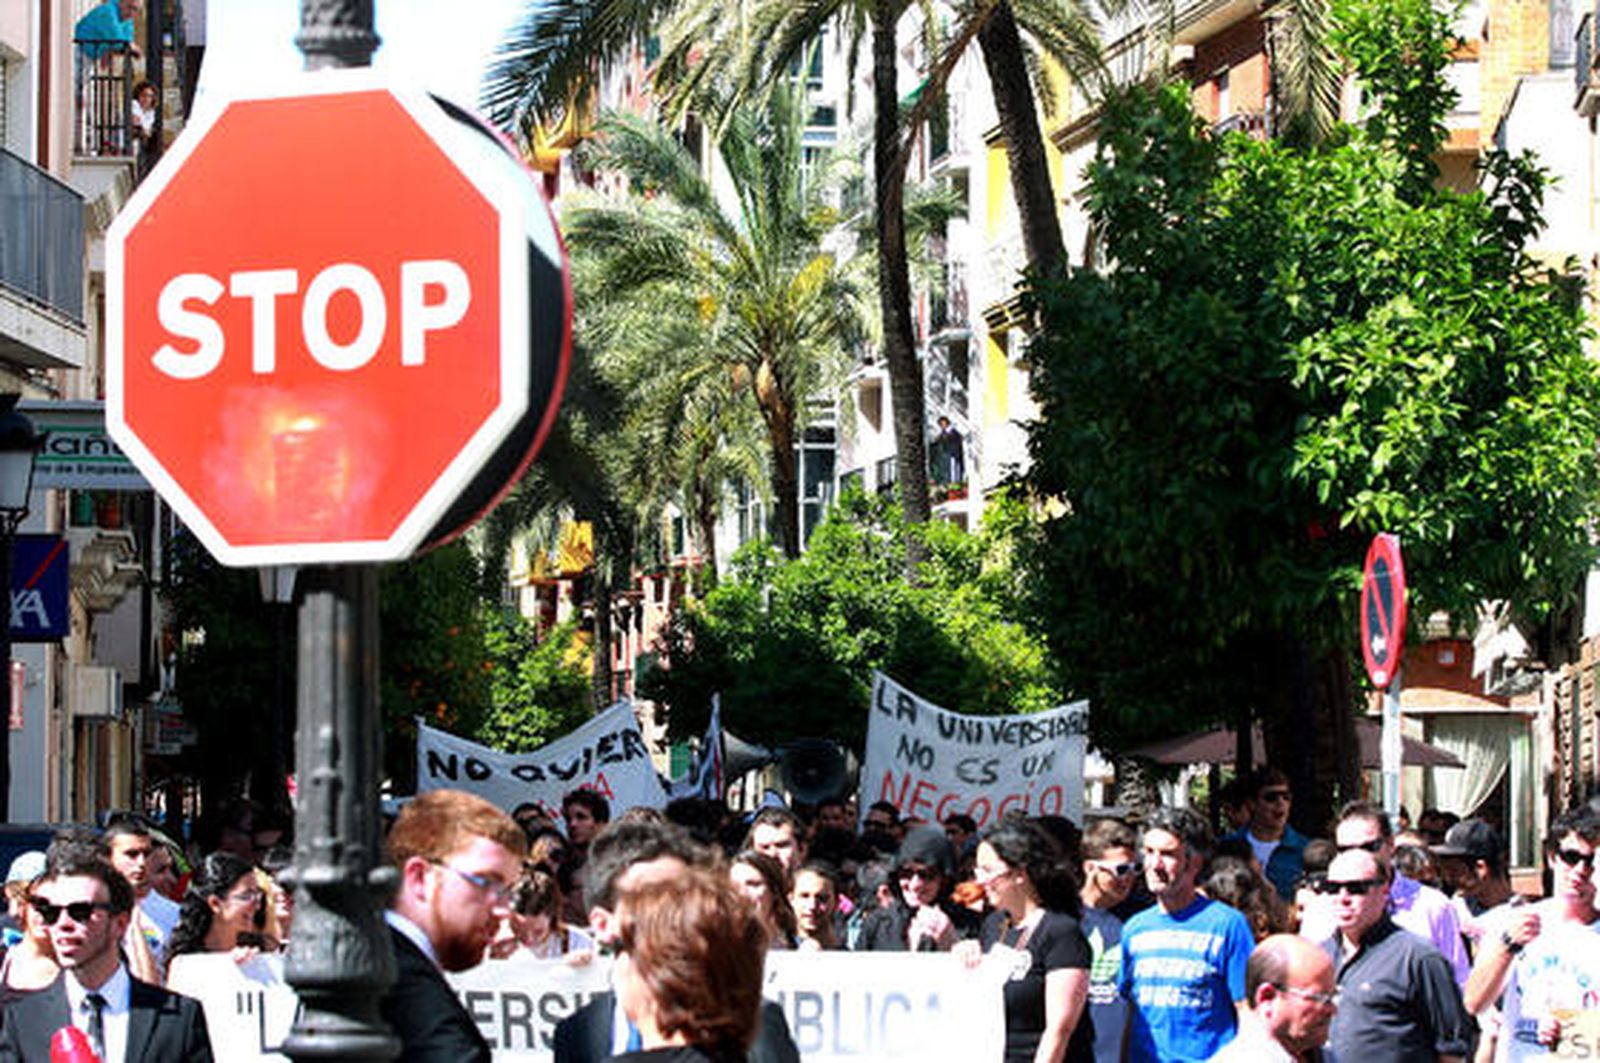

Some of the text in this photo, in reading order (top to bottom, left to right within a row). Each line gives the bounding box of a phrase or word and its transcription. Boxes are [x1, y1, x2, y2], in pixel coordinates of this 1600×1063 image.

[151, 260, 472, 379] STOP
[876, 680, 917, 725] LA
[427, 751, 491, 780] NO
[897, 734, 934, 771] NO
[956, 756, 999, 785] ES
[237, 991, 285, 1054] "L
